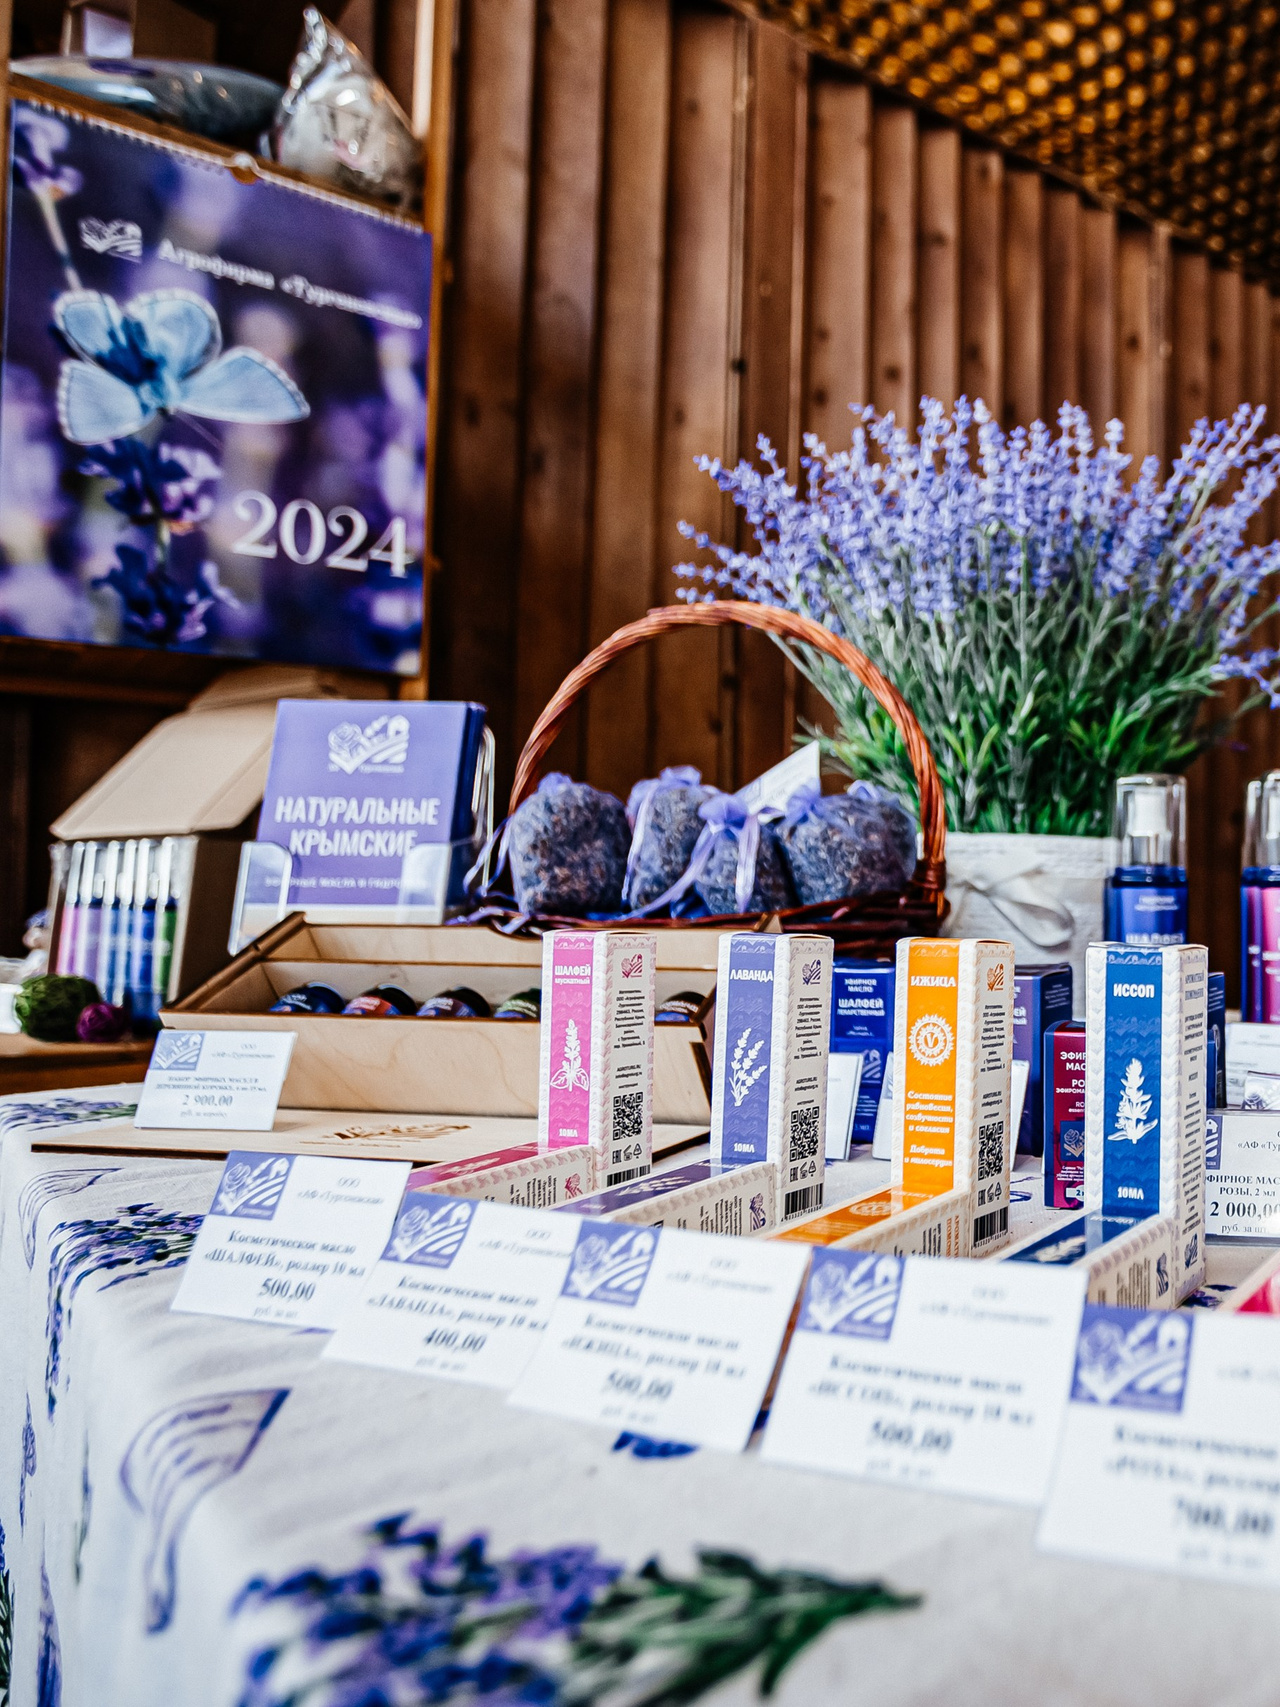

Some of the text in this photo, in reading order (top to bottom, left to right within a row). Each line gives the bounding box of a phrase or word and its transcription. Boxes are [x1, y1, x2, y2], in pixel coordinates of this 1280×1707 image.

[232, 489, 415, 579] 2024
[274, 796, 441, 827] НАТУРАЛЬНЫЕ
[289, 828, 418, 857] КРЫМСКИЕ
[554, 964, 592, 977] ШАЛФЕЙ
[729, 968, 774, 983] ЛАВАНДА
[554, 977, 591, 986] мускатный
[910, 975, 957, 988] ИЖИЦА
[1113, 983, 1155, 998] ИССОП
[837, 996, 884, 1010] ШАЛФЕЙ
[907, 1090, 953, 1102] Состояние
[733, 1142, 755, 1154] 10МЛ
[1237, 1140, 1259, 1150] «АФ
[1205, 1175, 1253, 1185] ФИРНОЕ
[1116, 1186, 1145, 1201] 10МЛ
[1219, 1186, 1276, 1198] РОЗЫ, 2 мл
[1209, 1200, 1220, 1217] 2
[1221, 1223, 1252, 1238] руб. за
[228, 1230, 356, 1256] Косметическое масло
[285, 1259, 331, 1277] роллер
[332, 1261, 348, 1275] 10
[349, 1265, 366, 1278] мл
[258, 1277, 317, 1301] 500,00
[396, 1275, 496, 1301] Косметическое
[423, 1327, 487, 1352] 400,00
